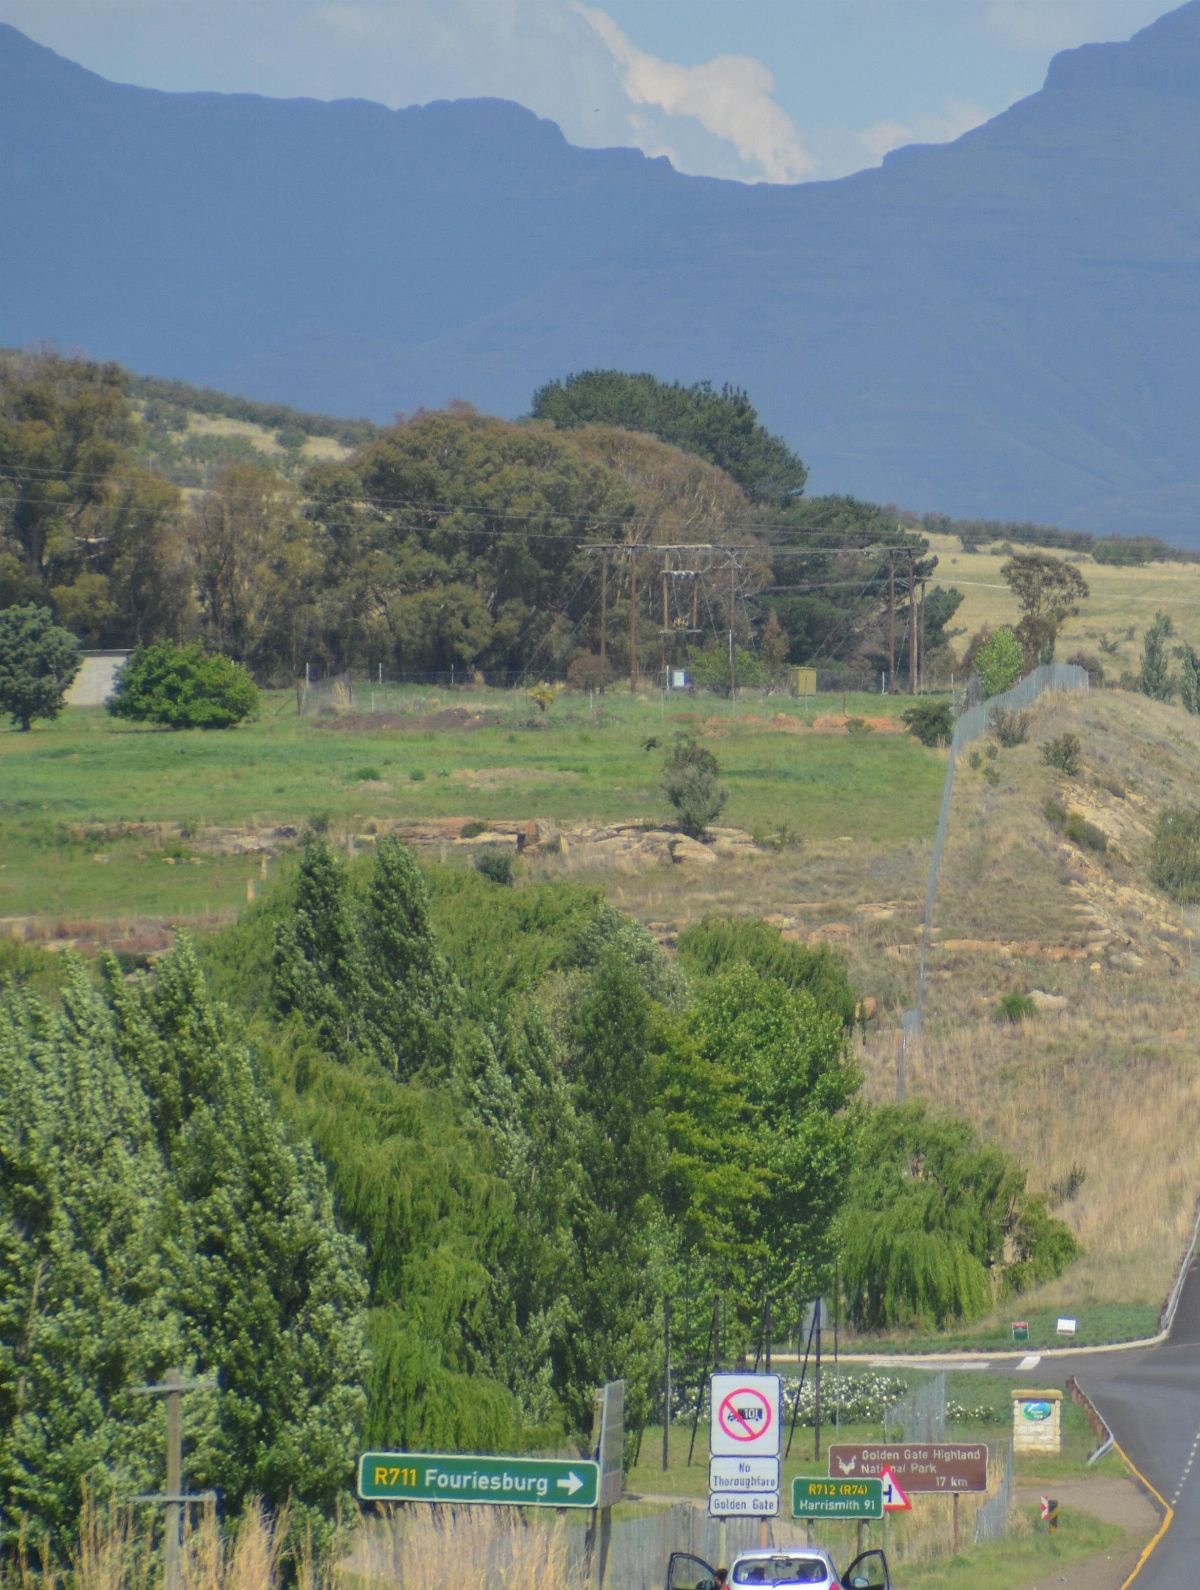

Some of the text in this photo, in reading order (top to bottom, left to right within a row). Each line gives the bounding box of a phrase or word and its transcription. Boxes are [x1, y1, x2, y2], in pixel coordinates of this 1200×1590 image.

[861, 1449, 981, 1462] Golden Gate Highland
[738, 1462, 751, 1473] No
[860, 1462, 937, 1474] Natinal Park
[374, 1466, 549, 1497] R711 Fouriesburg
[713, 1475, 776, 1489] Thoroughfare
[935, 1475, 968, 1487] 17 km
[807, 1483, 837, 1496] R712
[713, 1498, 775, 1510] Golden Gate
[799, 1499, 876, 1511] Harrismith 91
